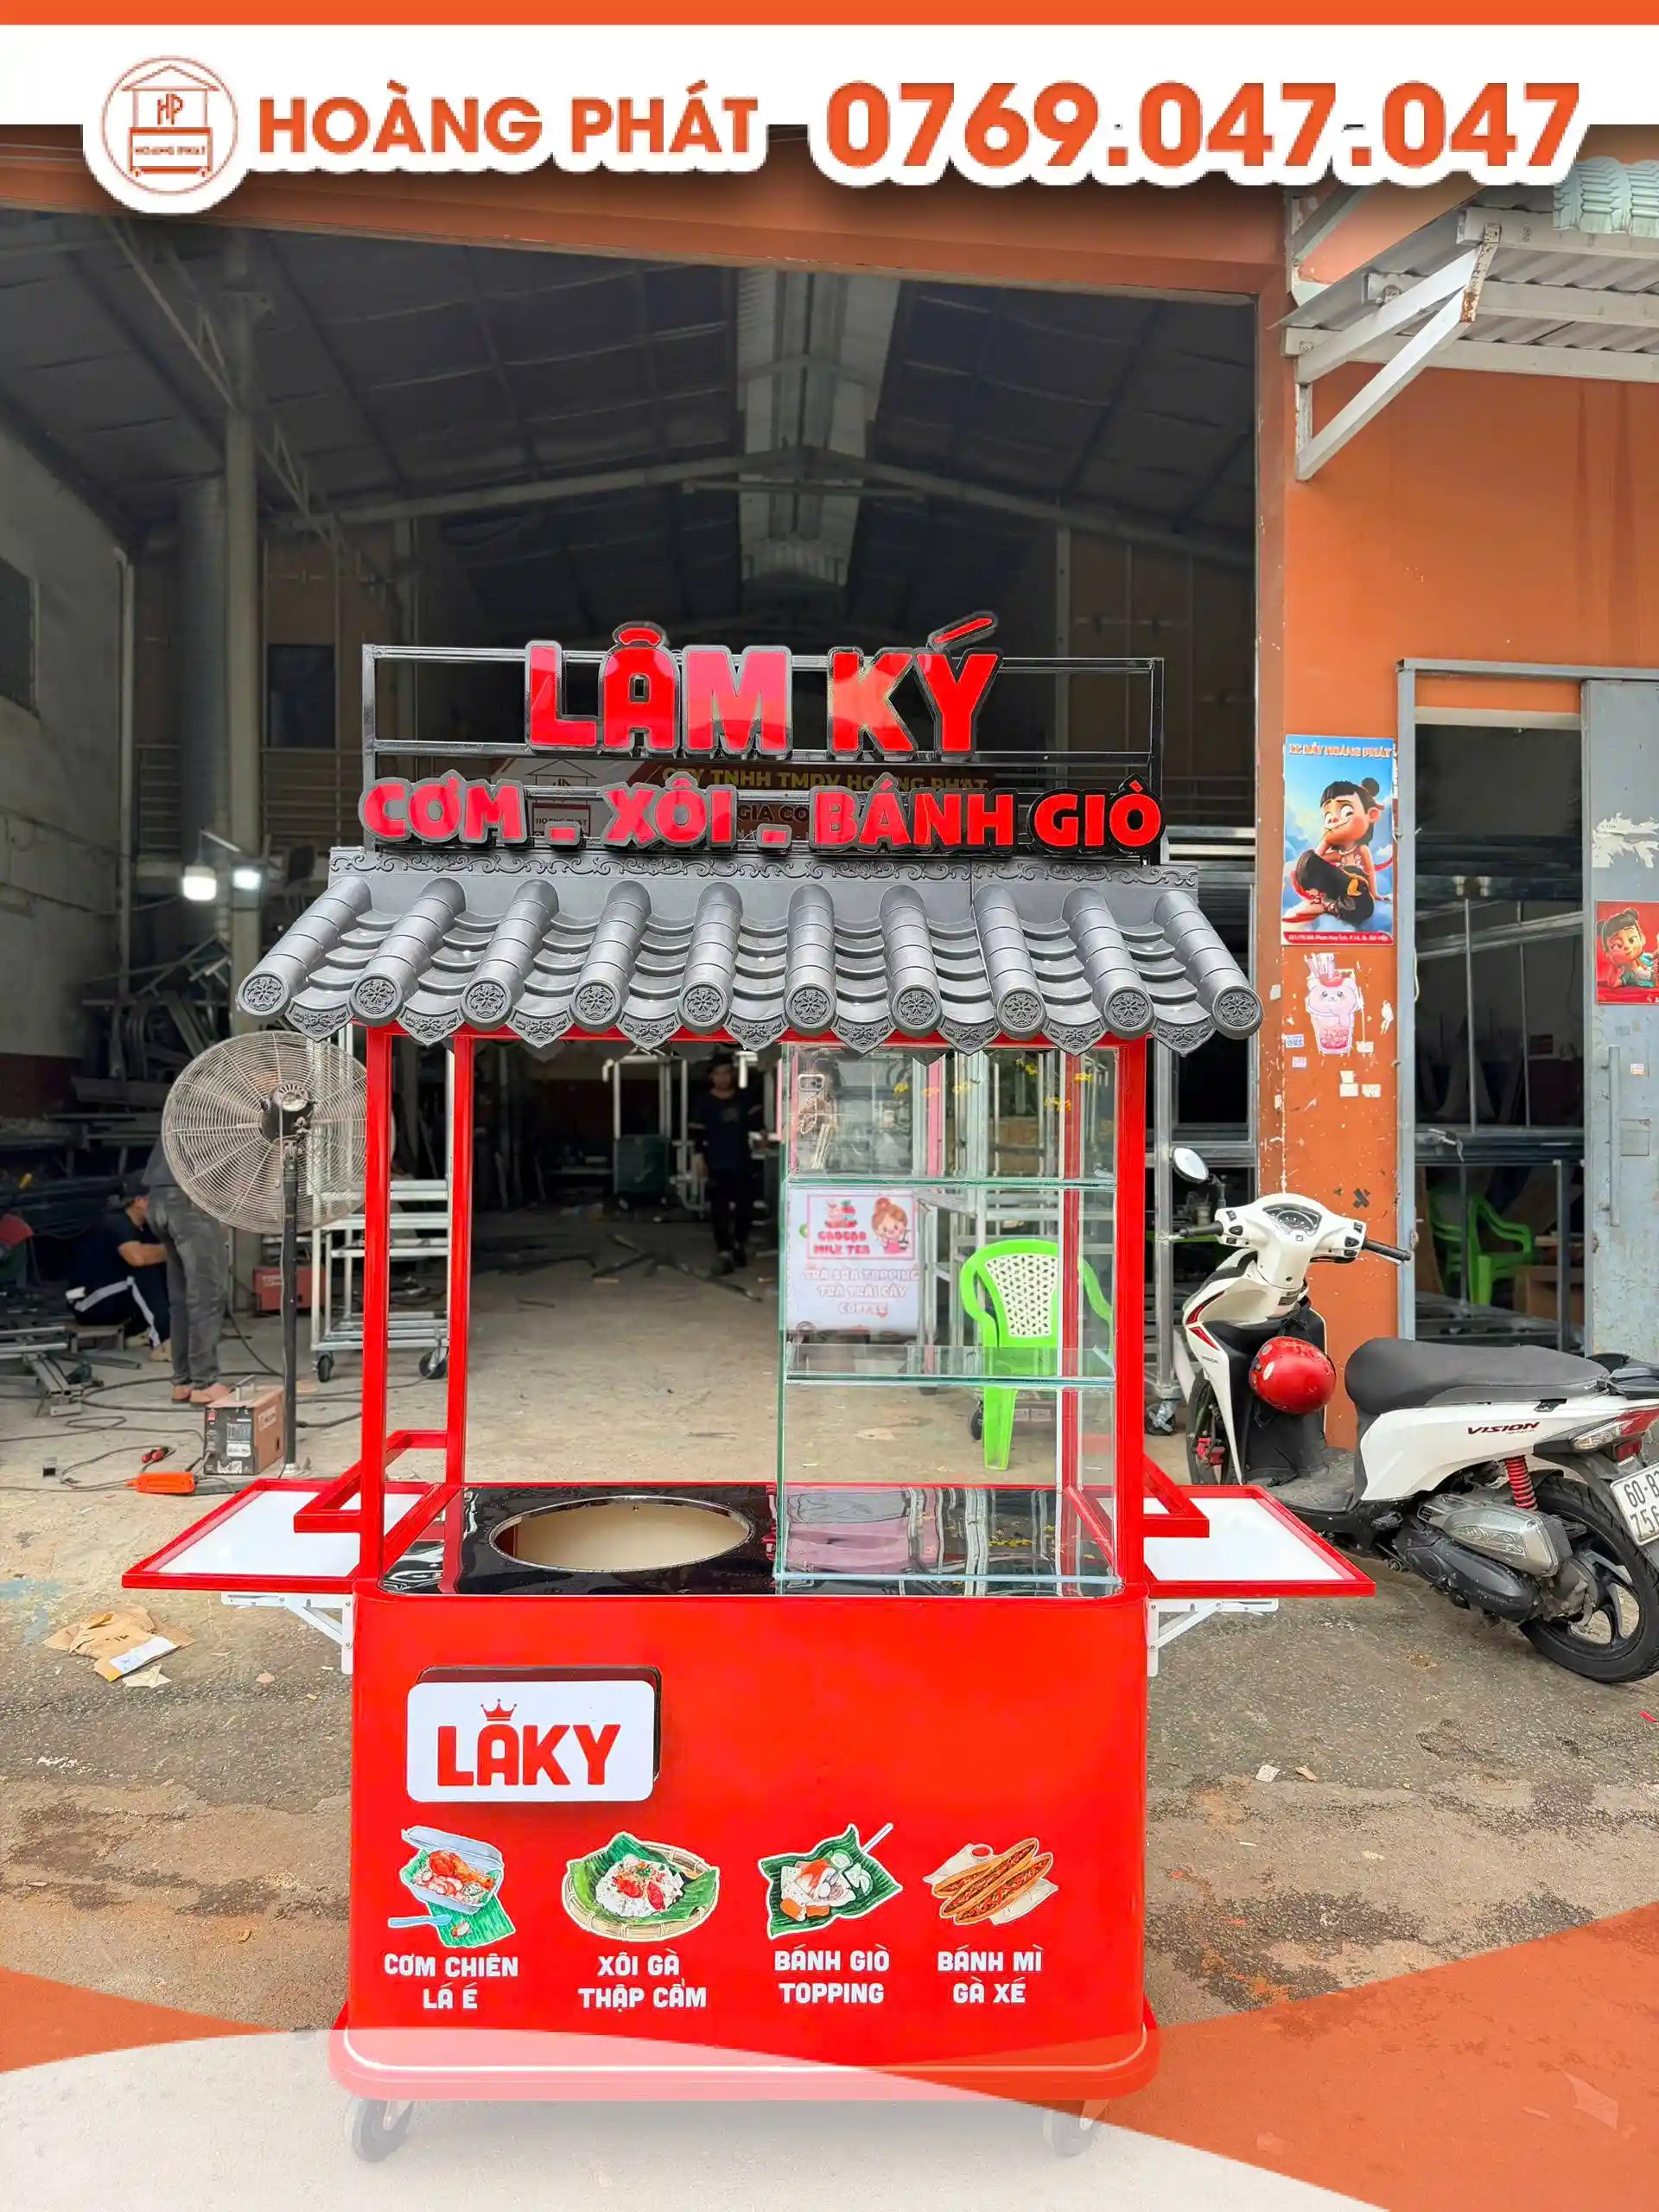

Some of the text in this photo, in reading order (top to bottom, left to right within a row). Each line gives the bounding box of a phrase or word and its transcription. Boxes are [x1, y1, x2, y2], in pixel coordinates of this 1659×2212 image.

[524, 612, 1001, 762] LÂM KÝ
[710, 769, 771, 787] TNHH
[847, 774, 925, 791] HONG
[359, 771, 527, 845] CƠM
[601, 772, 736, 849] XÔI
[809, 772, 1021, 850] BÁNH
[1030, 773, 1164, 852] GIÒ
[1467, 1421, 1541, 1434] VISION
[384, 1953, 518, 1978] CƠM CHIÊN
[597, 1948, 680, 1977] XÔI GÀ
[774, 1943, 890, 1972] BÁNH GIÒ
[938, 1943, 1044, 1972] BÁNH MÌ
[423, 1982, 479, 2010] LÁ É
[577, 1978, 707, 2012] THẬP CẨM
[778, 1982, 884, 2004] TOPPING
[953, 1976, 1027, 2004] GÀ XÉ
